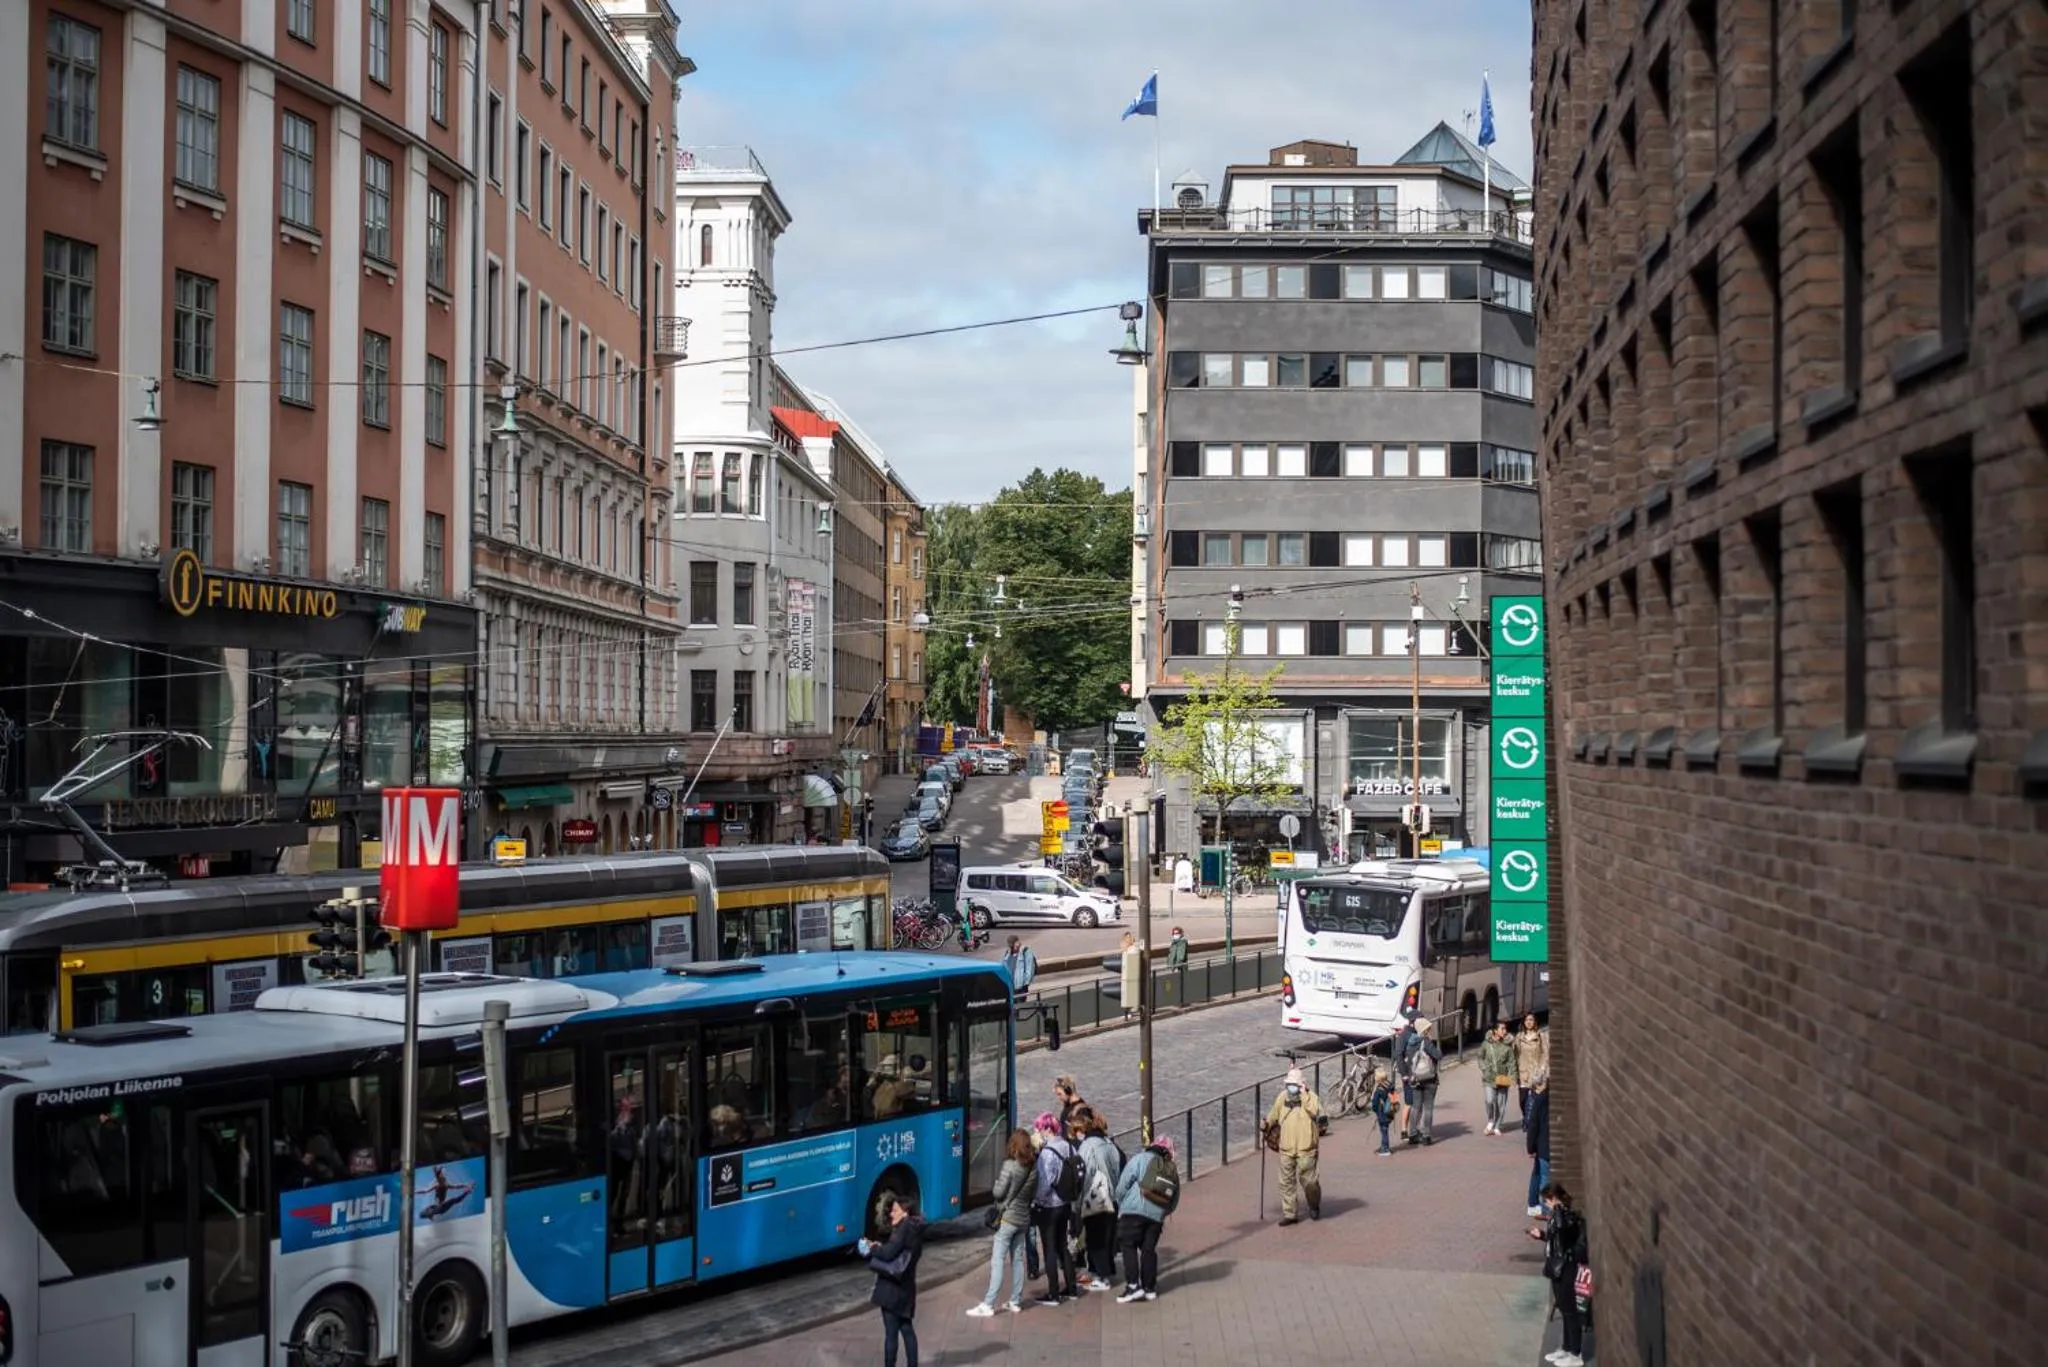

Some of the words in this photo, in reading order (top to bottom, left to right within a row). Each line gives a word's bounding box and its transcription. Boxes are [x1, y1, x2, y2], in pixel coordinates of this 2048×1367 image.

[207, 579, 337, 619] FINNKINO
[384, 602, 428, 633] SUBWAY
[802, 616, 813, 638] Thai
[802, 642, 815, 671] Ryan
[1496, 673, 1545, 687] Kierrätys-
[1496, 685, 1530, 696] keskus
[1356, 783, 1402, 795] FAZER
[1496, 796, 1545, 811] Kierrätys-
[1496, 808, 1530, 819] keskus
[408, 796, 459, 866] M
[1496, 919, 1544, 933] Kierrätys-
[1496, 931, 1529, 942] keskus
[152, 979, 163, 1004] 3
[36, 1085, 110, 1106] Pohjolan
[113, 1075, 183, 1096] Liikenne
[330, 1184, 391, 1226] rush
